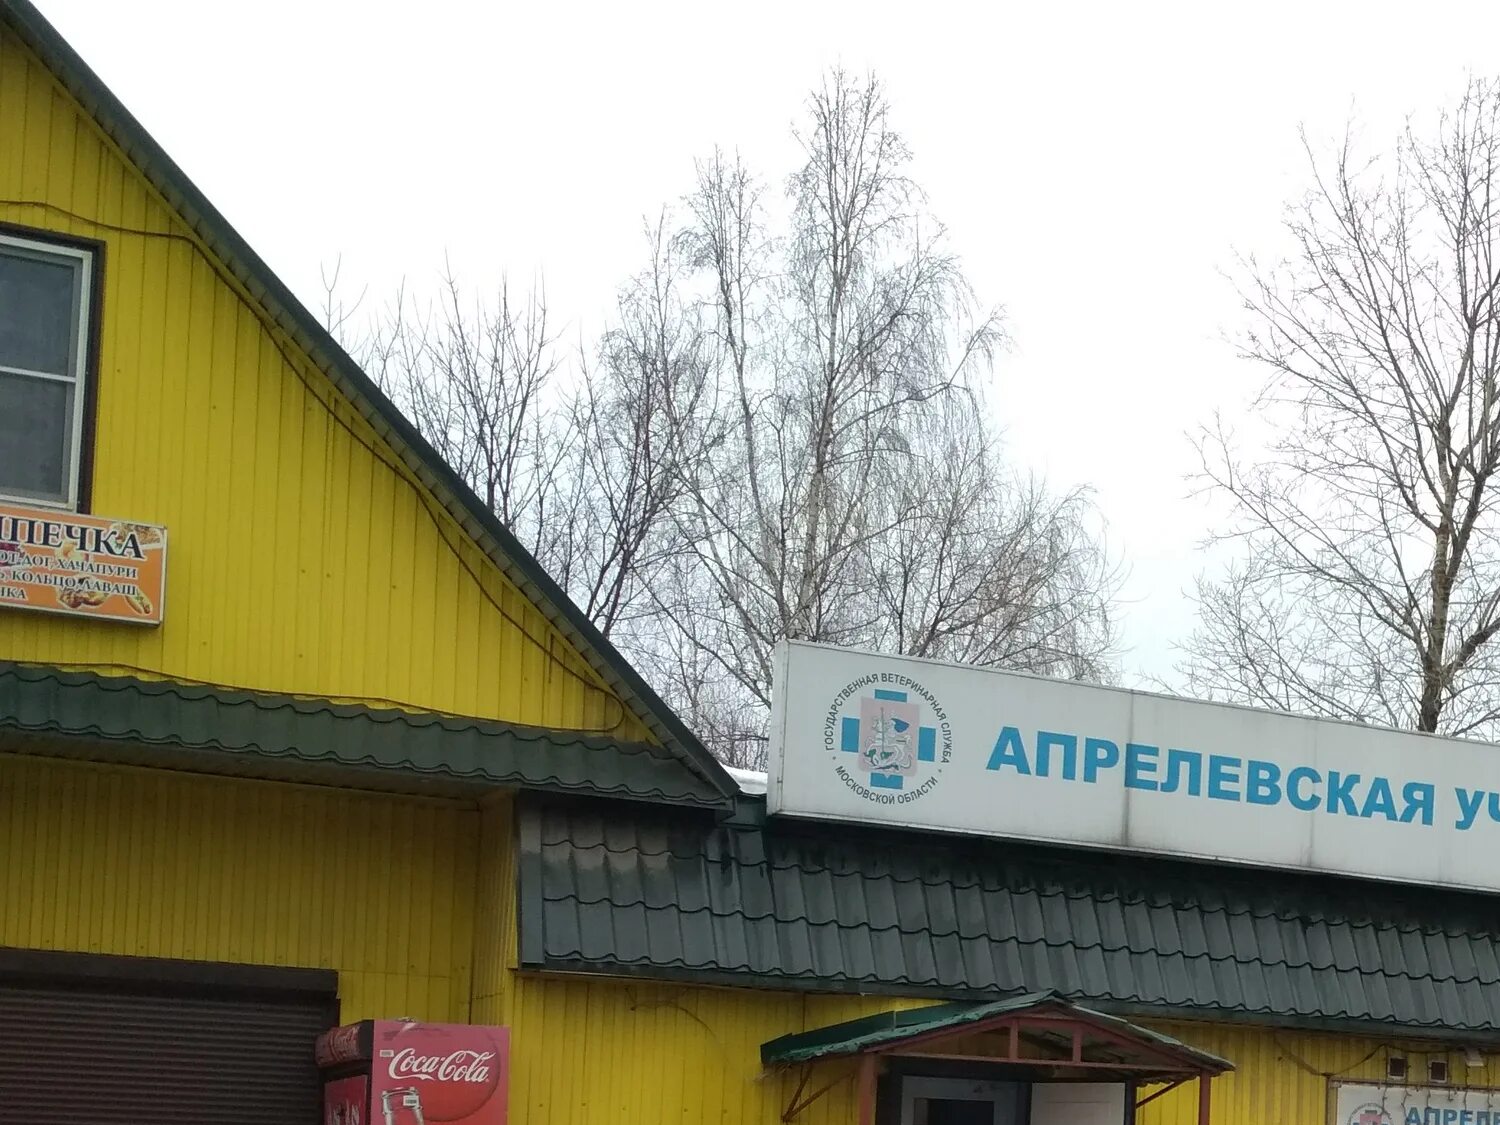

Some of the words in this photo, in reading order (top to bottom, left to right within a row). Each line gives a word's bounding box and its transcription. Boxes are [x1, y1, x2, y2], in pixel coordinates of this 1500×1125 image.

[0, 516, 144, 559] ПЕЧКА
[58, 558, 138, 579] ХАЧАПУРИ
[824, 673, 879, 751] ГОСУДАРСТВЕННАЯ
[881, 672, 947, 722] ВЕТЕРИНАРНАЯ
[940, 722, 953, 764] СЛУЖБА
[835, 765, 895, 805] МОСКОВСКОЙ
[897, 776, 938, 805] ОБЛАСТИ
[986, 725, 1436, 827] АПРЕЛЕВСКАЯ
[388, 1047, 496, 1083] Coca-Cola
